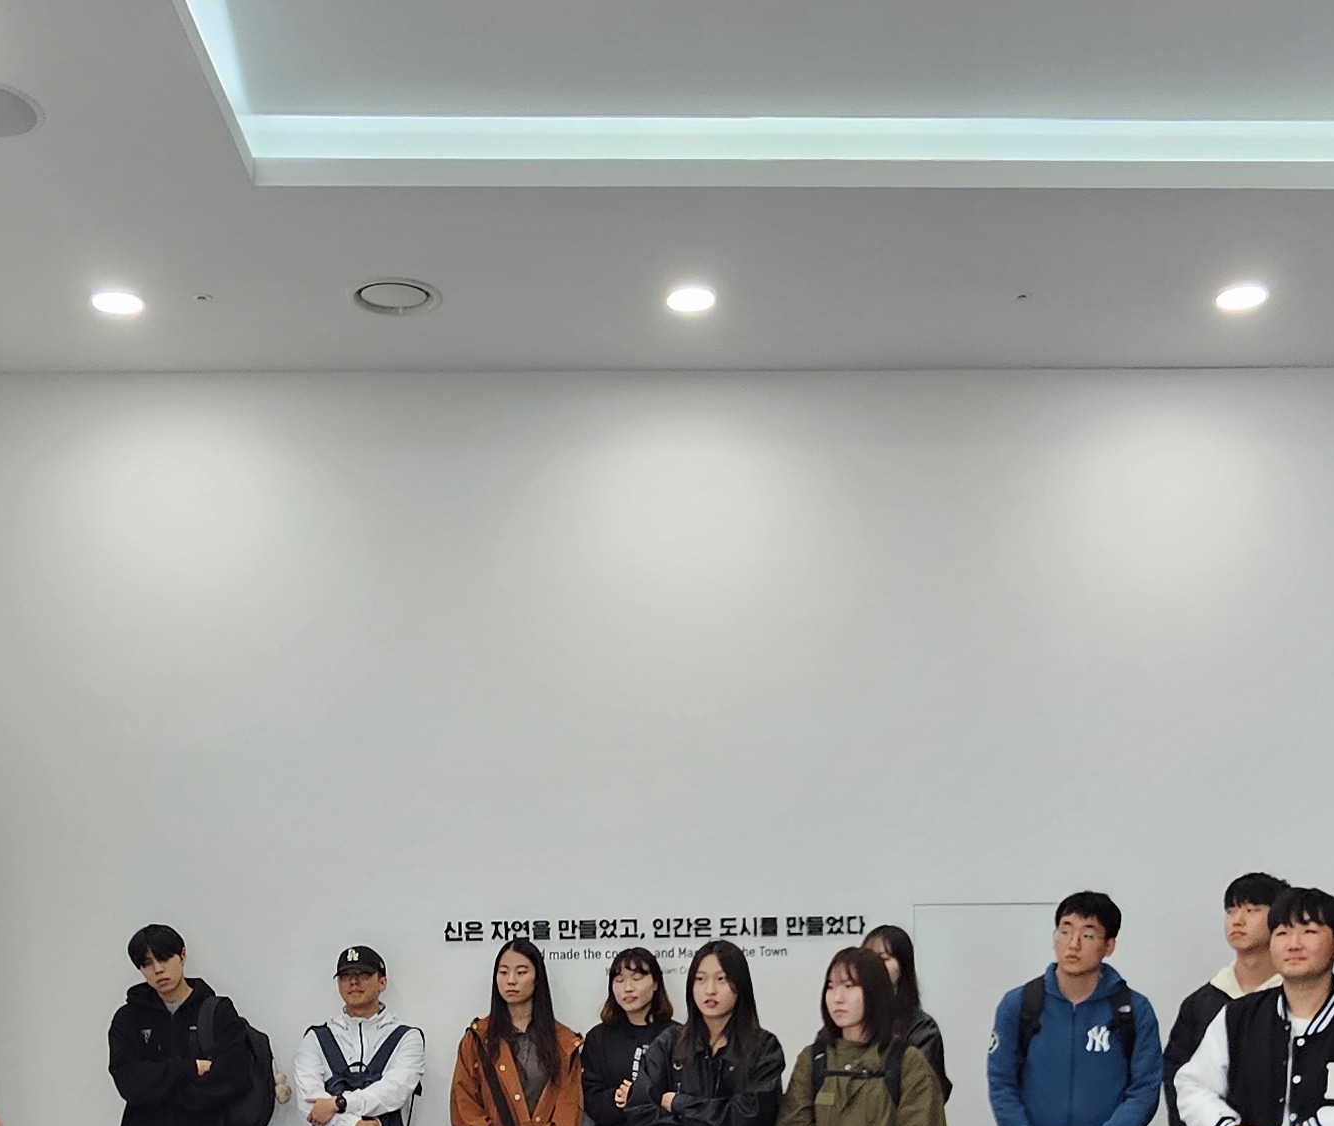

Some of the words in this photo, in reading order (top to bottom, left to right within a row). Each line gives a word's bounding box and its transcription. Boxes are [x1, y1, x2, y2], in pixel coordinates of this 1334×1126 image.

[444, 920, 483, 942] 신은
[491, 919, 551, 941] 자연을
[558, 918, 646, 940] 만들었고,
[652, 917, 712, 939] 인간은
[719, 916, 778, 938] 도시를
[785, 915, 866, 937] 만들었다
[549, 948, 580, 960] made
[583, 948, 602, 960] the
[654, 946, 675, 958] and
[678, 946, 695, 958] Ma
[759, 945, 788, 957] Town
